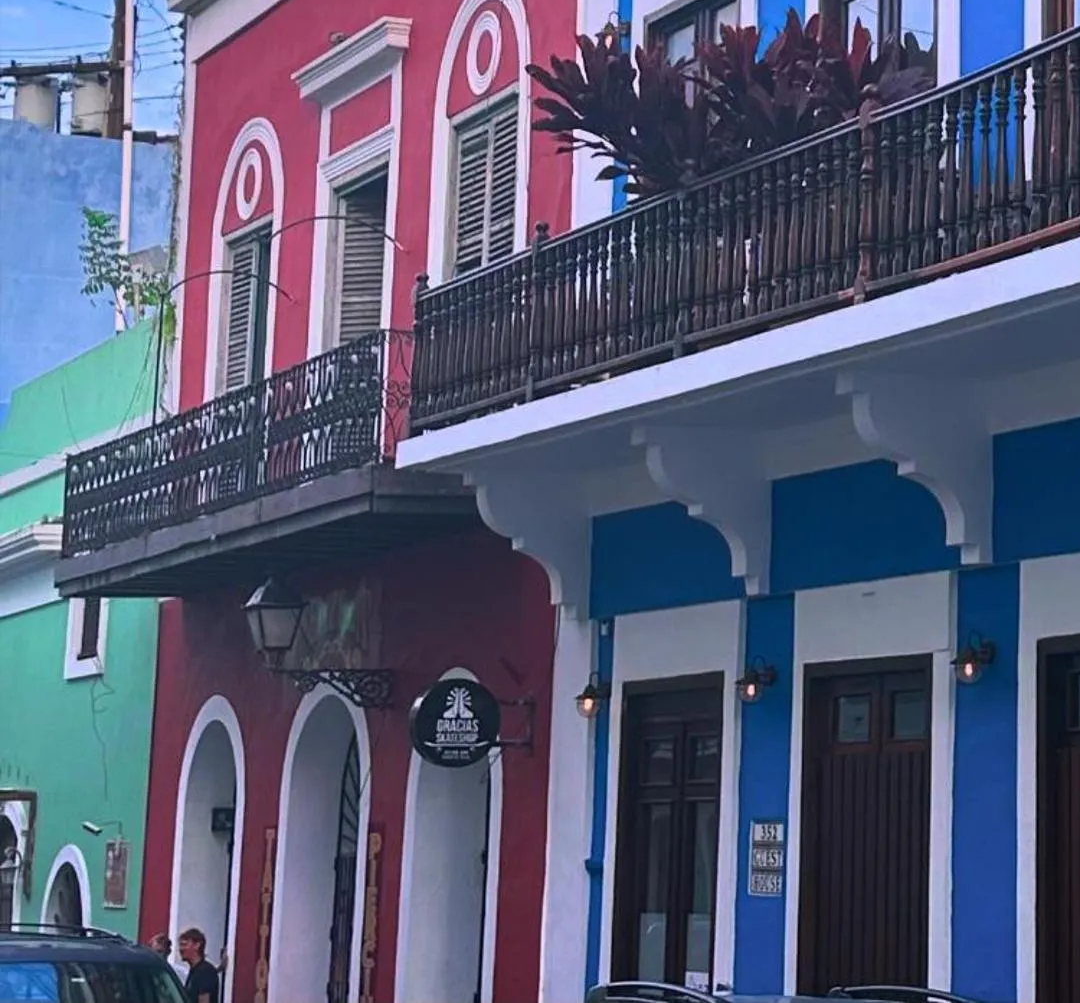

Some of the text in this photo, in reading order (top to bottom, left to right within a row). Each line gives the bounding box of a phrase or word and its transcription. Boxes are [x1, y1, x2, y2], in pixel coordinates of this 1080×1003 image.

[436, 719, 479, 733] GRACIAS
[761, 825, 778, 840] 352
[360, 832, 382, 1003] PIERCI
